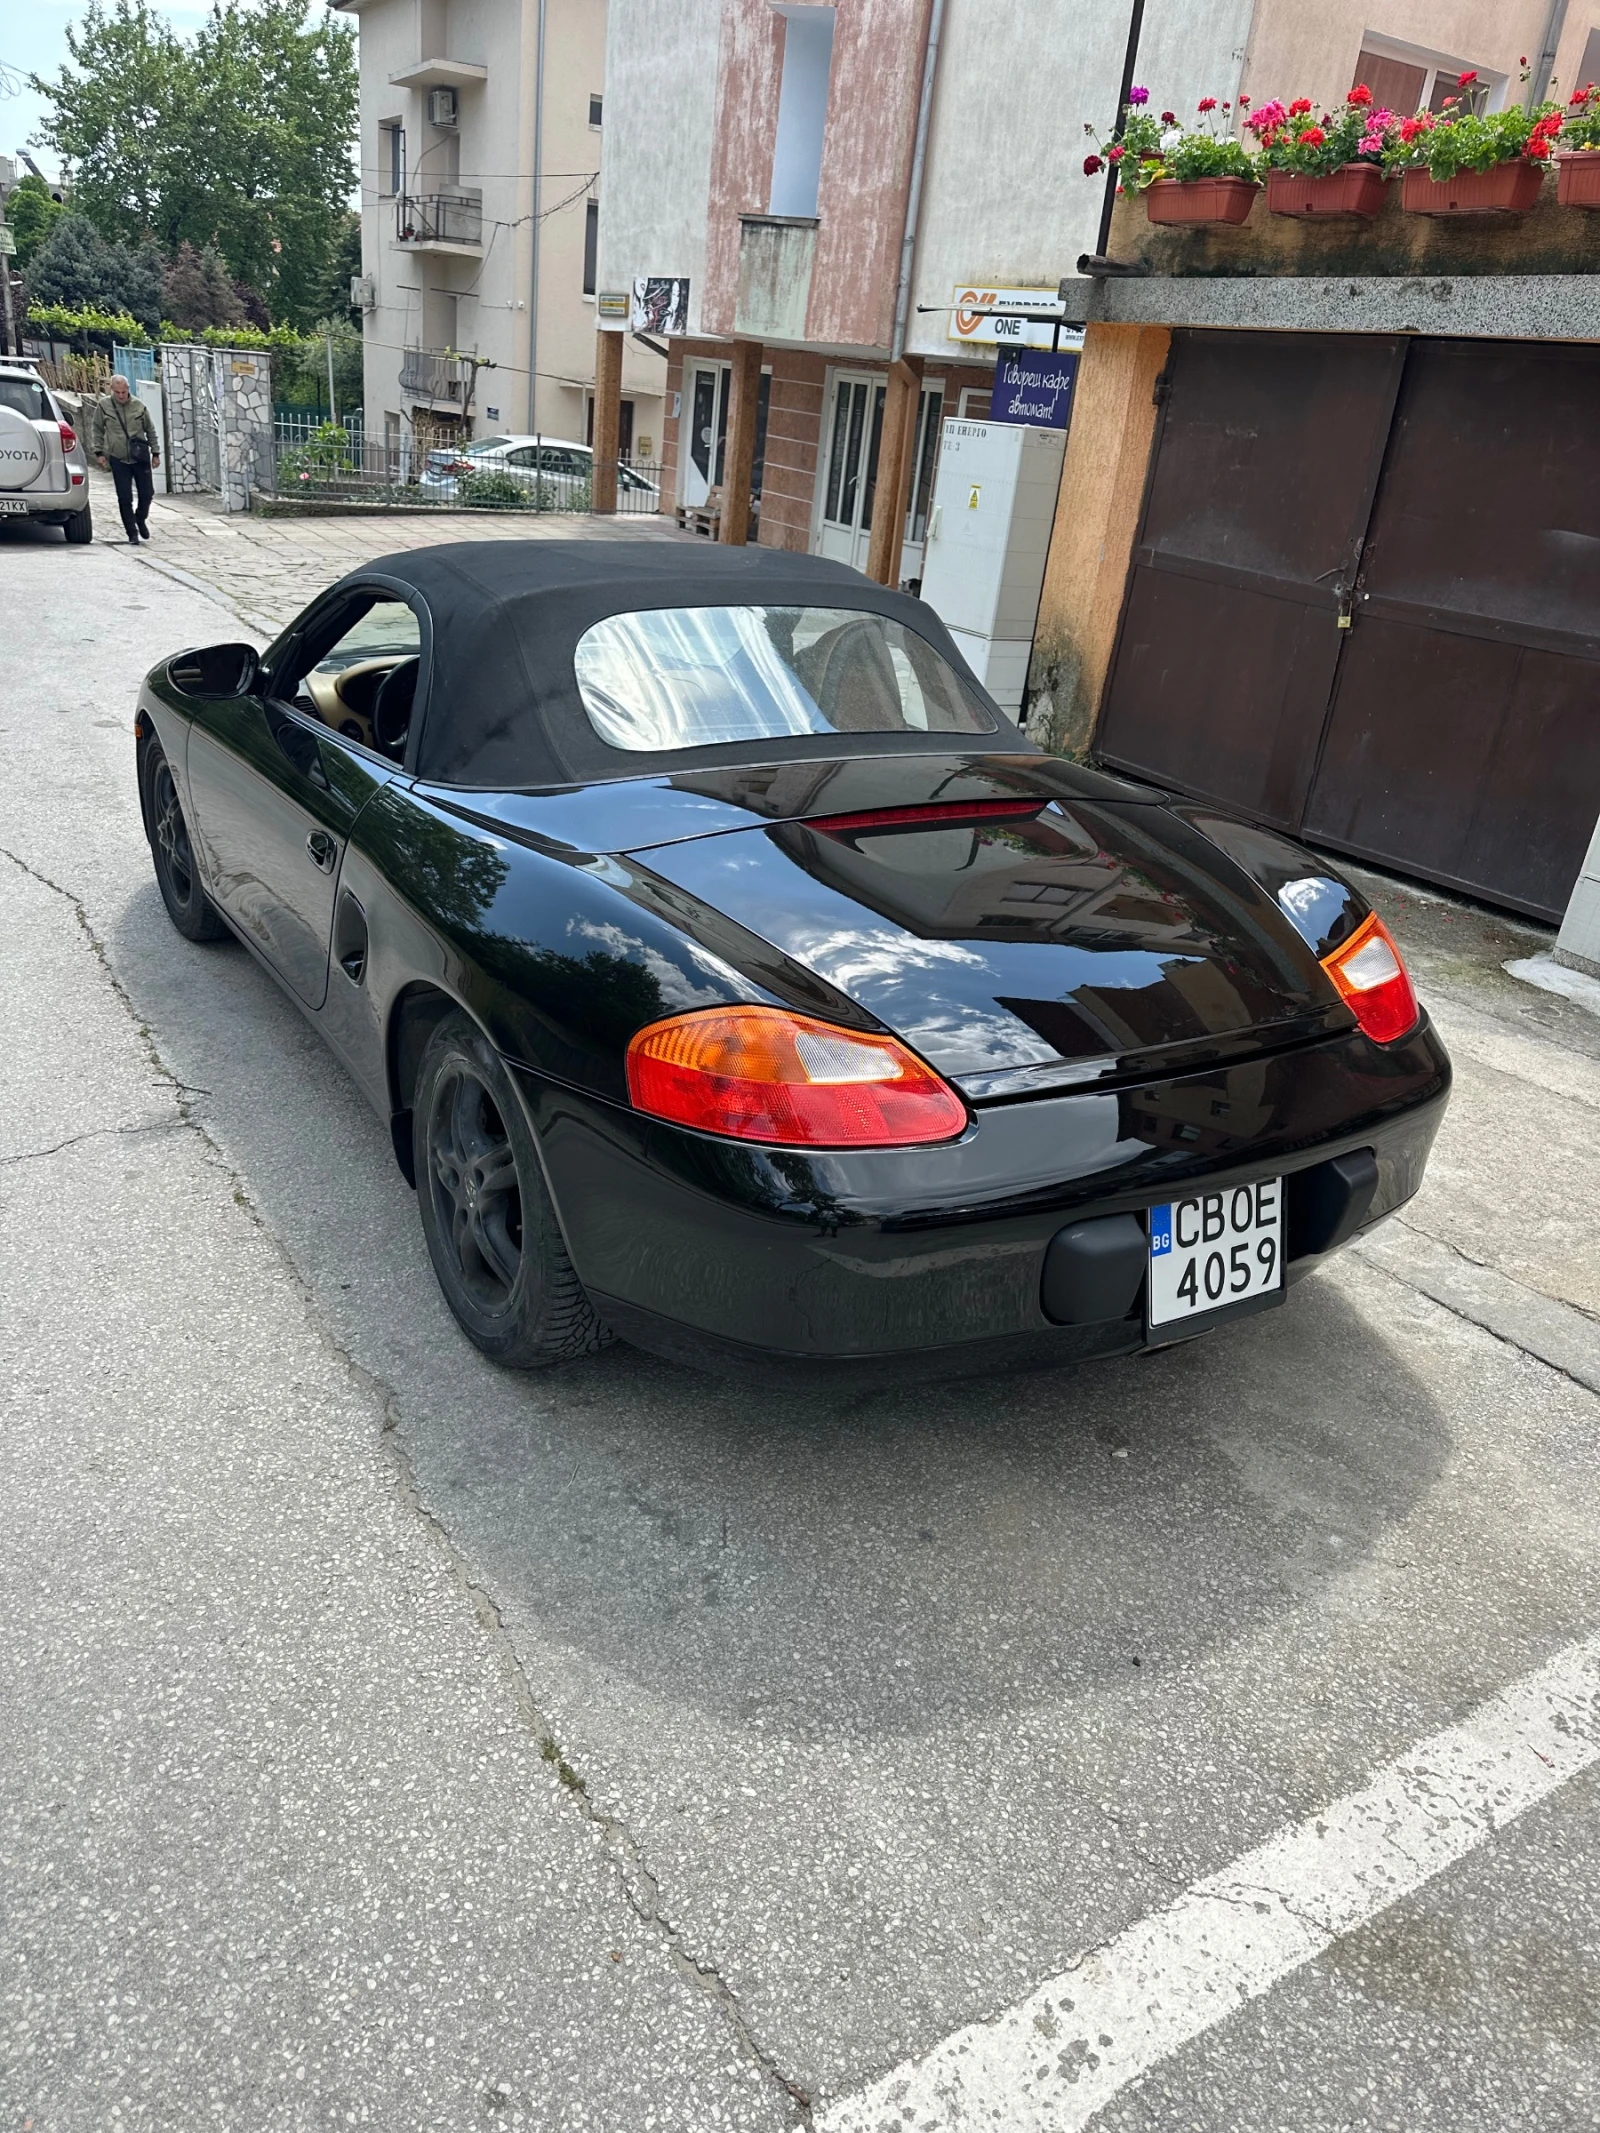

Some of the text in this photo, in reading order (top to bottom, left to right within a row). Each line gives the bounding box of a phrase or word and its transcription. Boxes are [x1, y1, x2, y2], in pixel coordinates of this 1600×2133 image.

[994, 318, 1021, 336] ONE
[1042, 369, 1070, 401] кафе
[1008, 394, 1055, 420] автомат!
[1152, 1233, 1170, 1251] BG
[1176, 1236, 1276, 1307] 4059
